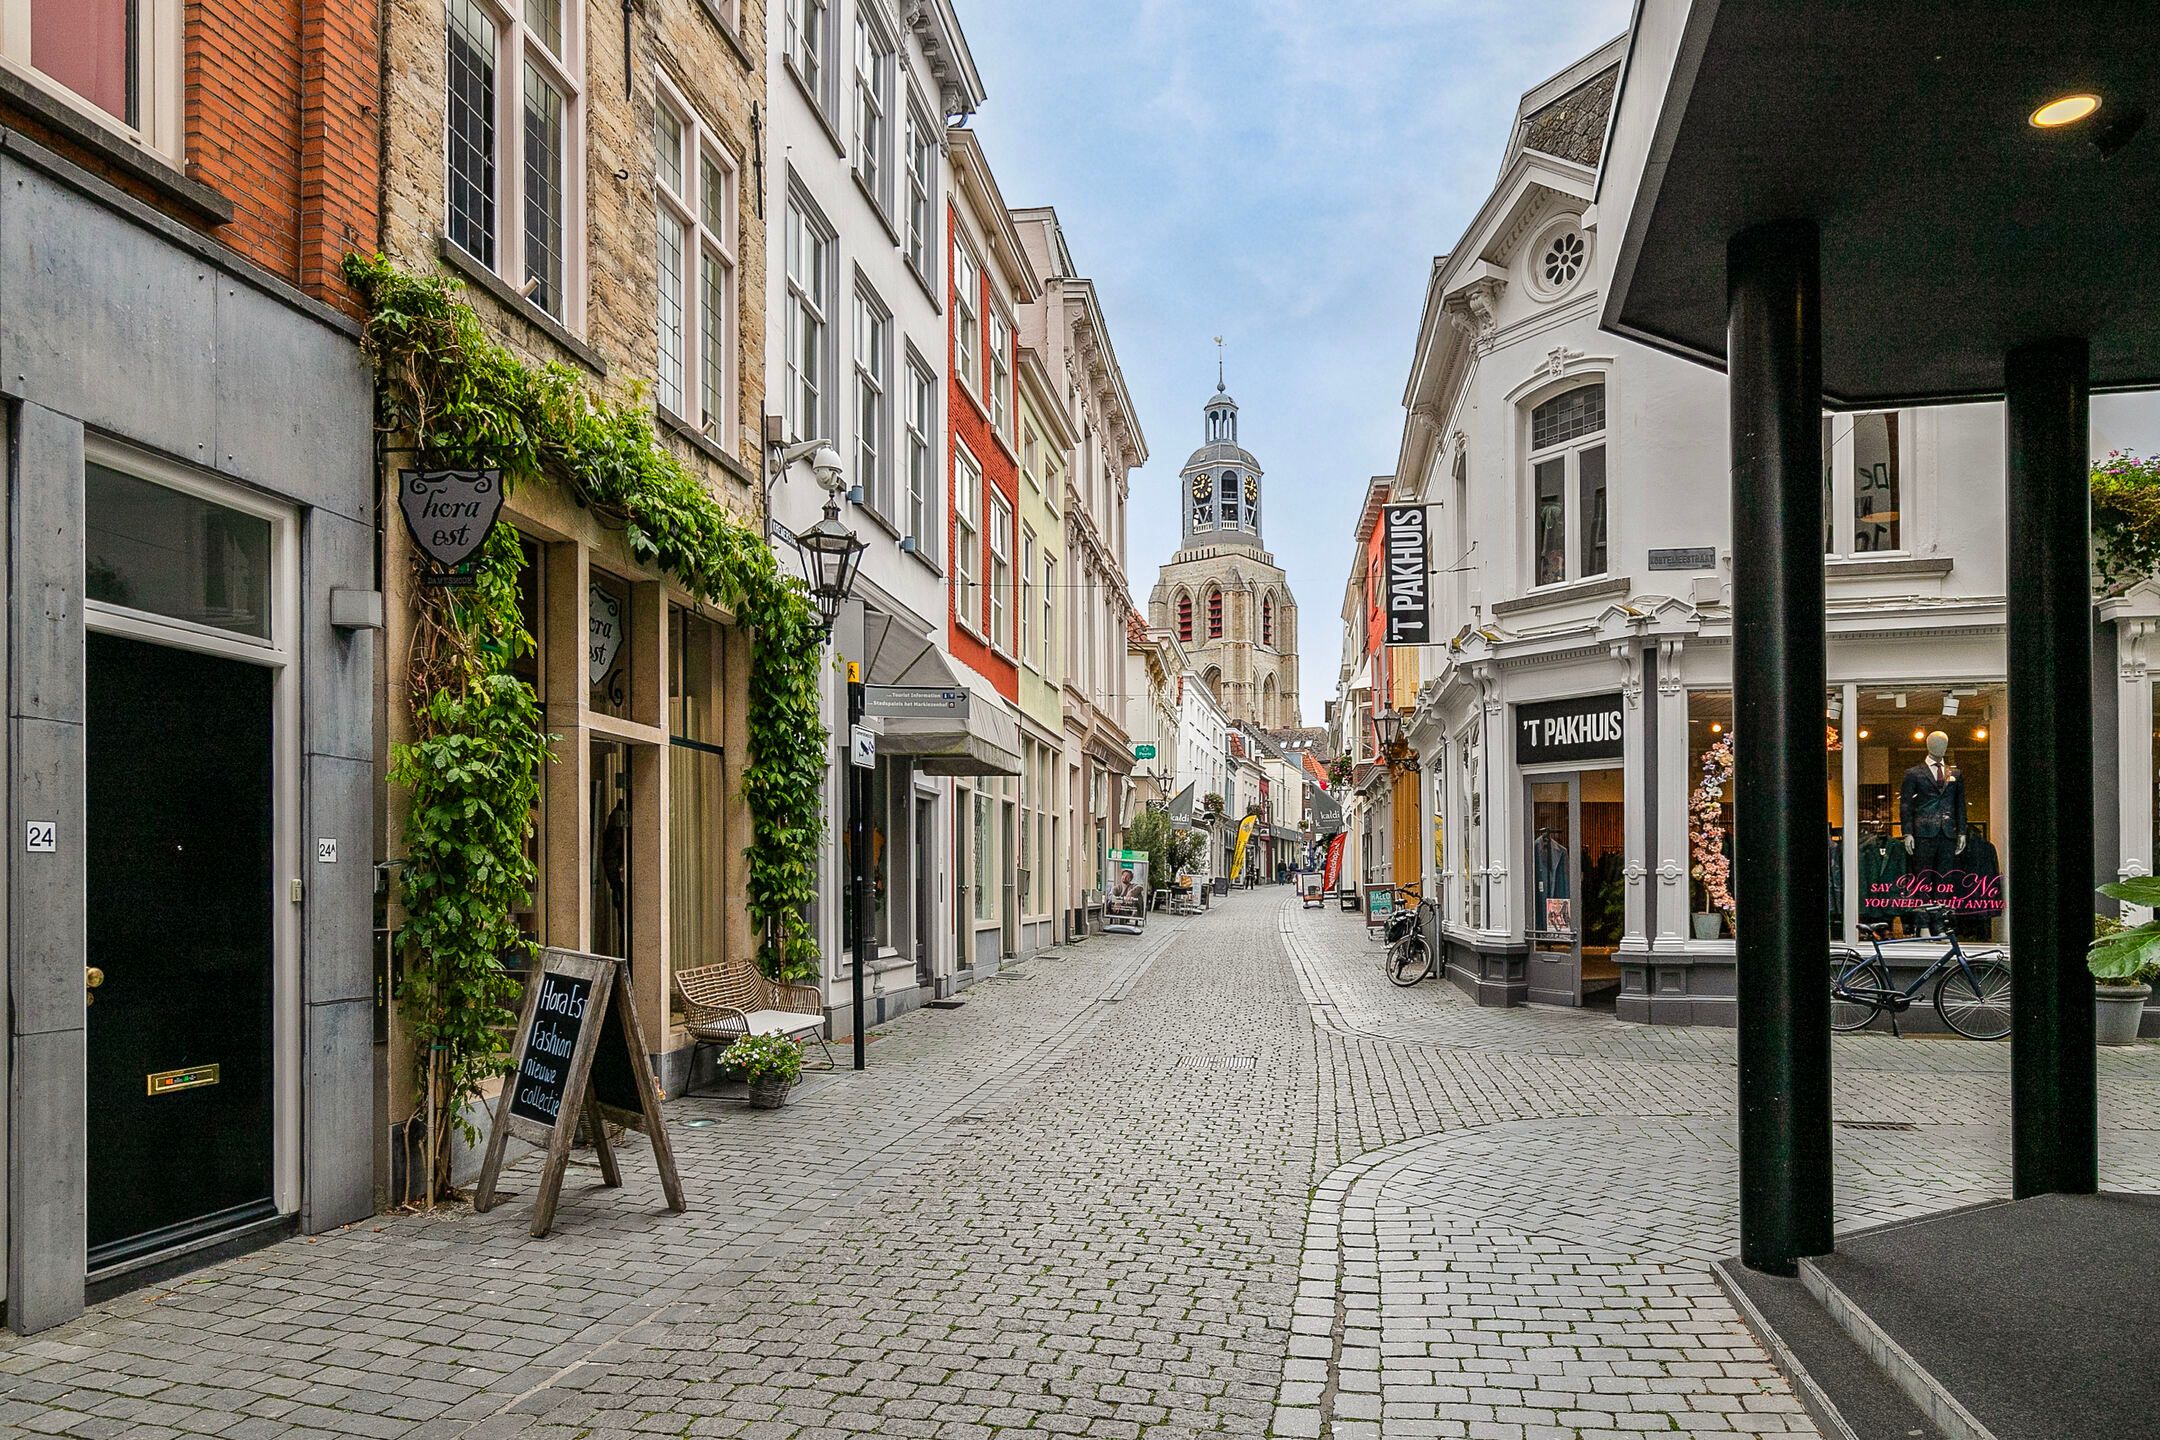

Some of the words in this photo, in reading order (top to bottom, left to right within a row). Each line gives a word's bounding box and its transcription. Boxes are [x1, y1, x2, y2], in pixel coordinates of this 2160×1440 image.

[422, 487, 482, 519] hora
[432, 525, 471, 546] est
[1390, 509, 1424, 611] PAKHUIS
[589, 617, 613, 640] ora
[1544, 710, 1622, 747] PAKHUIS
[1320, 810, 1340, 820] kaldi
[29, 827, 54, 847] 24
[319, 843, 336, 857] 24A
[1870, 883, 1893, 893] SAY
[1896, 873, 1933, 898] Yes
[1936, 883, 1954, 893] OR
[1961, 873, 2003, 900] No
[1864, 898, 1889, 908] YOU
[1890, 898, 1924, 908] NEED
[1965, 899, 2009, 909] ANYWA
[540, 979, 569, 1015] Hora
[531, 1020, 572, 1059] Fashion
[525, 1057, 557, 1084] nieuwe
[521, 1085, 561, 1117] collectie
